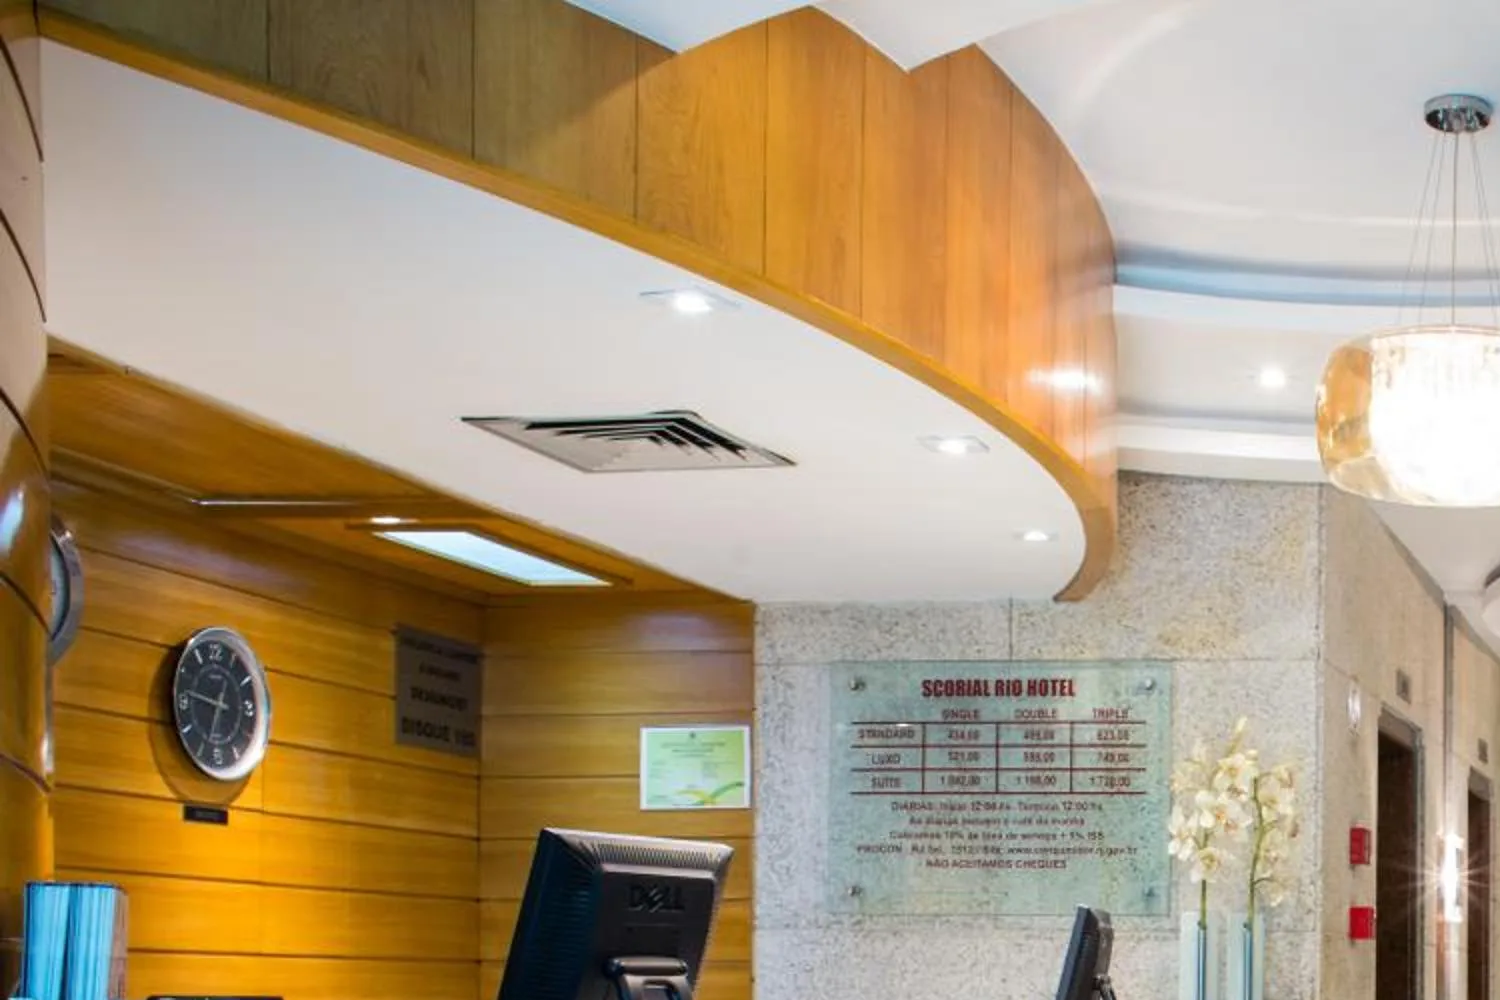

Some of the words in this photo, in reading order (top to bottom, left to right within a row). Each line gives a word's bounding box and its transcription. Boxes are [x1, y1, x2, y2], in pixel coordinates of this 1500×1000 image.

[921, 679, 990, 697] SCORIAL
[995, 679, 1023, 697] RIO
[1027, 679, 1076, 697] HOTEL
[941, 708, 980, 720] SINGLE
[1014, 707, 1057, 719] DOUBLE
[1092, 707, 1130, 719] TRIPLE
[858, 728, 915, 740] STANDARD
[871, 753, 901, 765] LUXO
[926, 858, 949, 868] NÃO
[952, 859, 1012, 869] ACEITAMOS
[1016, 859, 1067, 869] CHEQUES
[628, 884, 685, 913] DELL
